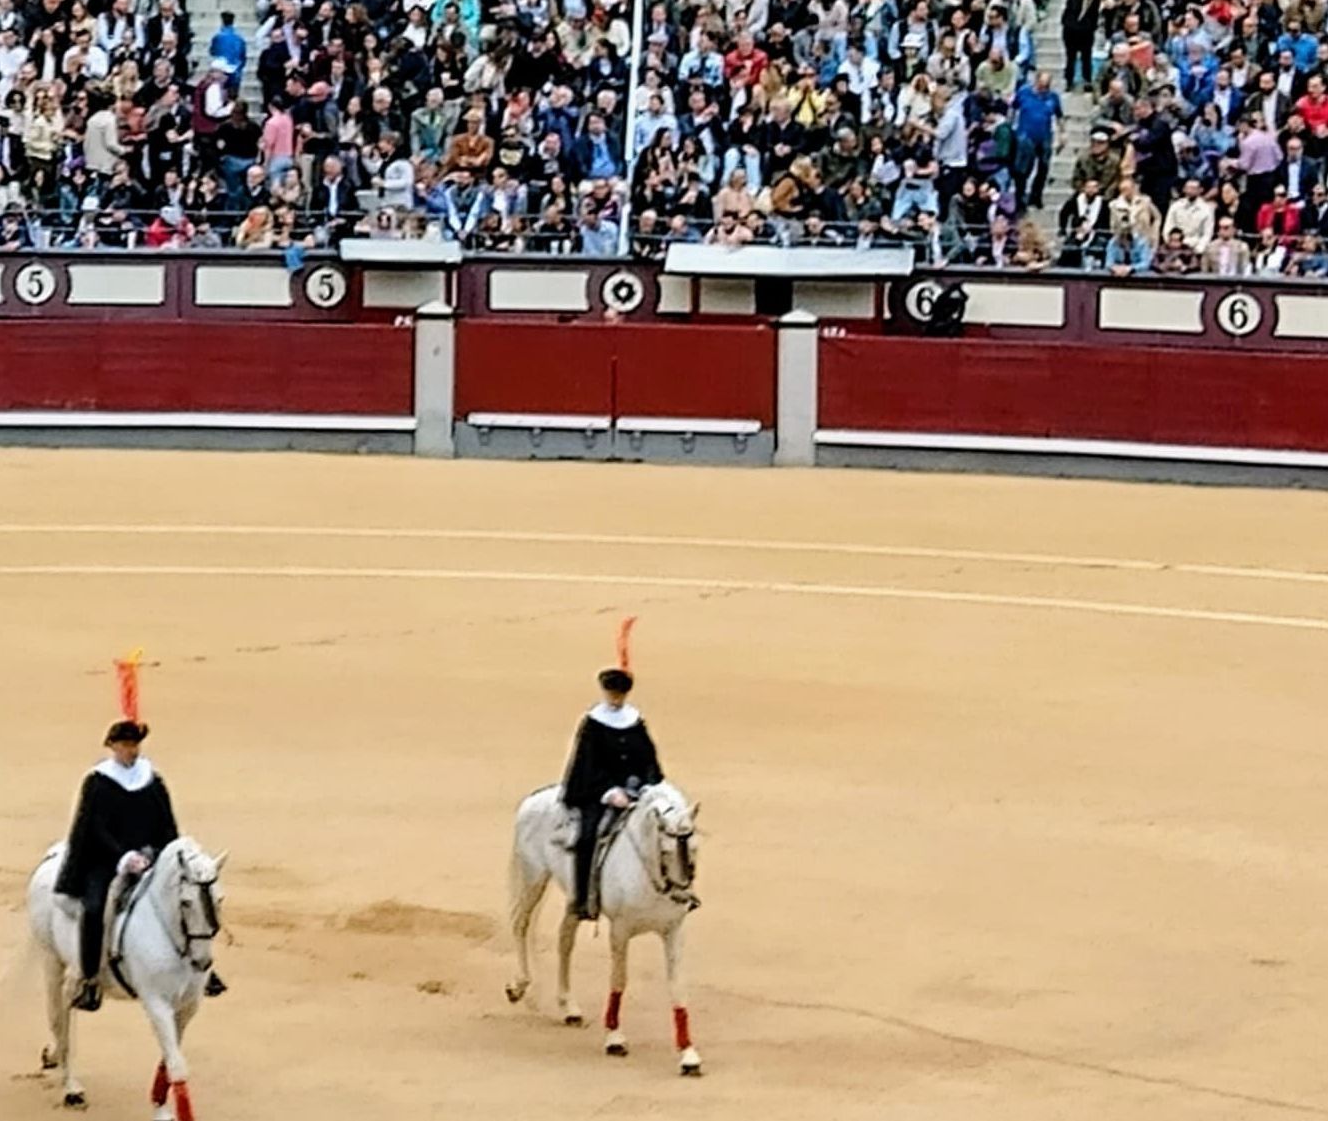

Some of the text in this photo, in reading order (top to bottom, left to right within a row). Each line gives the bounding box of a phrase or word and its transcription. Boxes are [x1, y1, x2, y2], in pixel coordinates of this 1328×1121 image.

[28, 270, 44, 298] 5
[318, 273, 336, 302] 5
[916, 287, 935, 317] 6
[1228, 298, 1249, 330] 6
